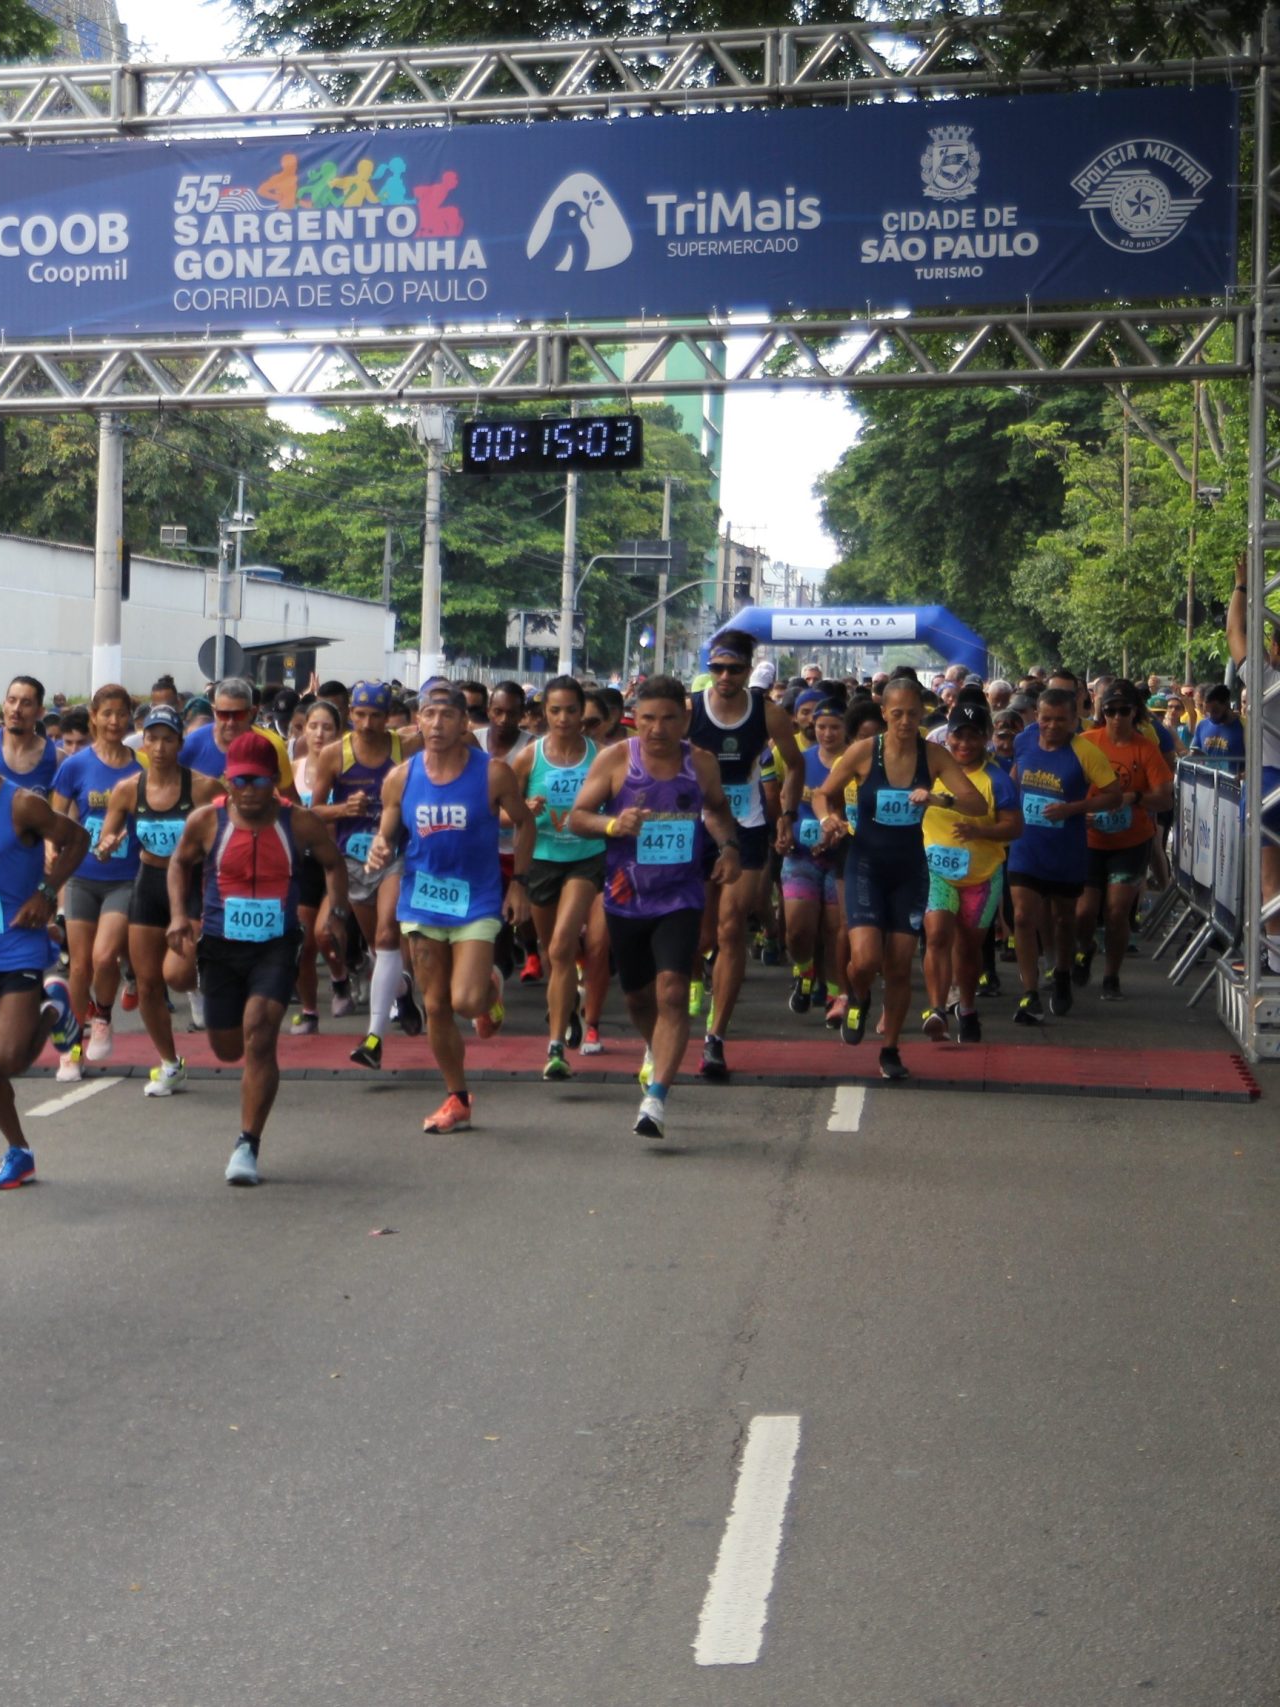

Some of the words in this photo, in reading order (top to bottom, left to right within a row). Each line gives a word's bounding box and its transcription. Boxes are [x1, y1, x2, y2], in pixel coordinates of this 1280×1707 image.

[1077, 143, 1138, 193] POLICIA
[1143, 143, 1206, 188] MILITAR
[646, 187, 821, 236] TriMais
[882, 208, 977, 232] CIDADE
[984, 206, 1018, 227] DE
[173, 205, 417, 246] SARGENTO
[173, 239, 488, 281] GONZAGUINHA
[667, 237, 799, 258] SUPERMERCADO
[861, 233, 927, 264] SÃO
[933, 232, 1039, 260] PAULO
[28, 258, 128, 287] Coopmil
[914, 265, 984, 280] TURISMO
[173, 285, 292, 311] CORRIDA
[298, 284, 332, 307] DE
[340, 278, 394, 306] SÃO
[403, 278, 487, 304] PAULO
[789, 617, 897, 627] LARGADA
[416, 805, 467, 830] SUB
[142, 832, 176, 846] 4131
[642, 833, 685, 849] 4478
[418, 883, 460, 902] 4280
[230, 911, 276, 928] 4002
